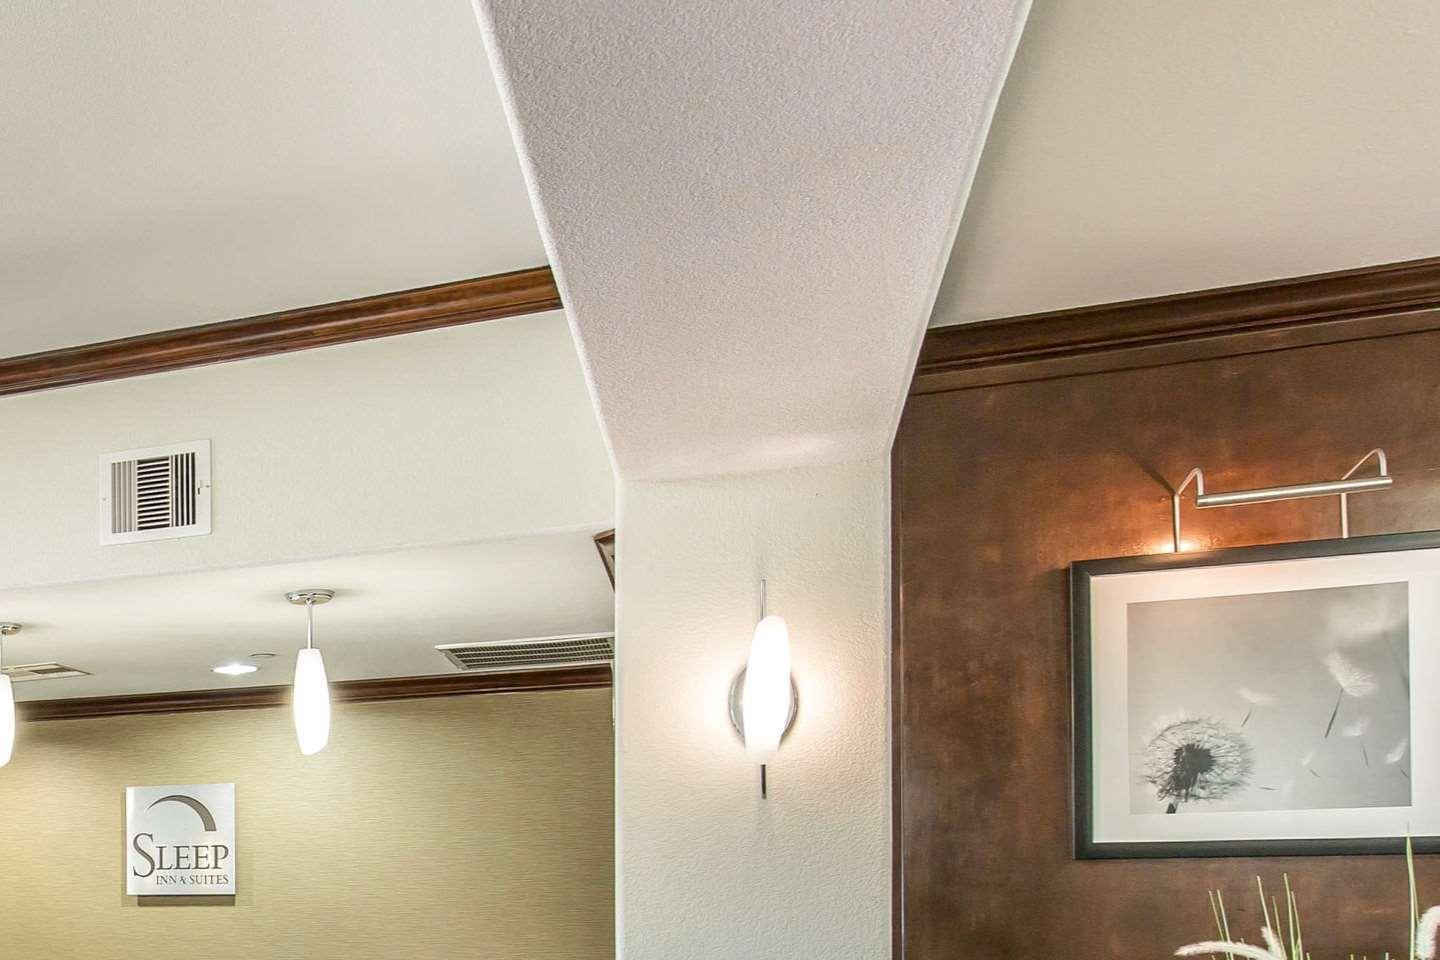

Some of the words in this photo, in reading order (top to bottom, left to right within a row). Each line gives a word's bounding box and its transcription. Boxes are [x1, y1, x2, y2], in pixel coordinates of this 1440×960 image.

[133, 833, 229, 877] SLEEP
[156, 875, 177, 885] INN
[178, 875, 188, 885] &
[189, 874, 229, 885] SUITES
